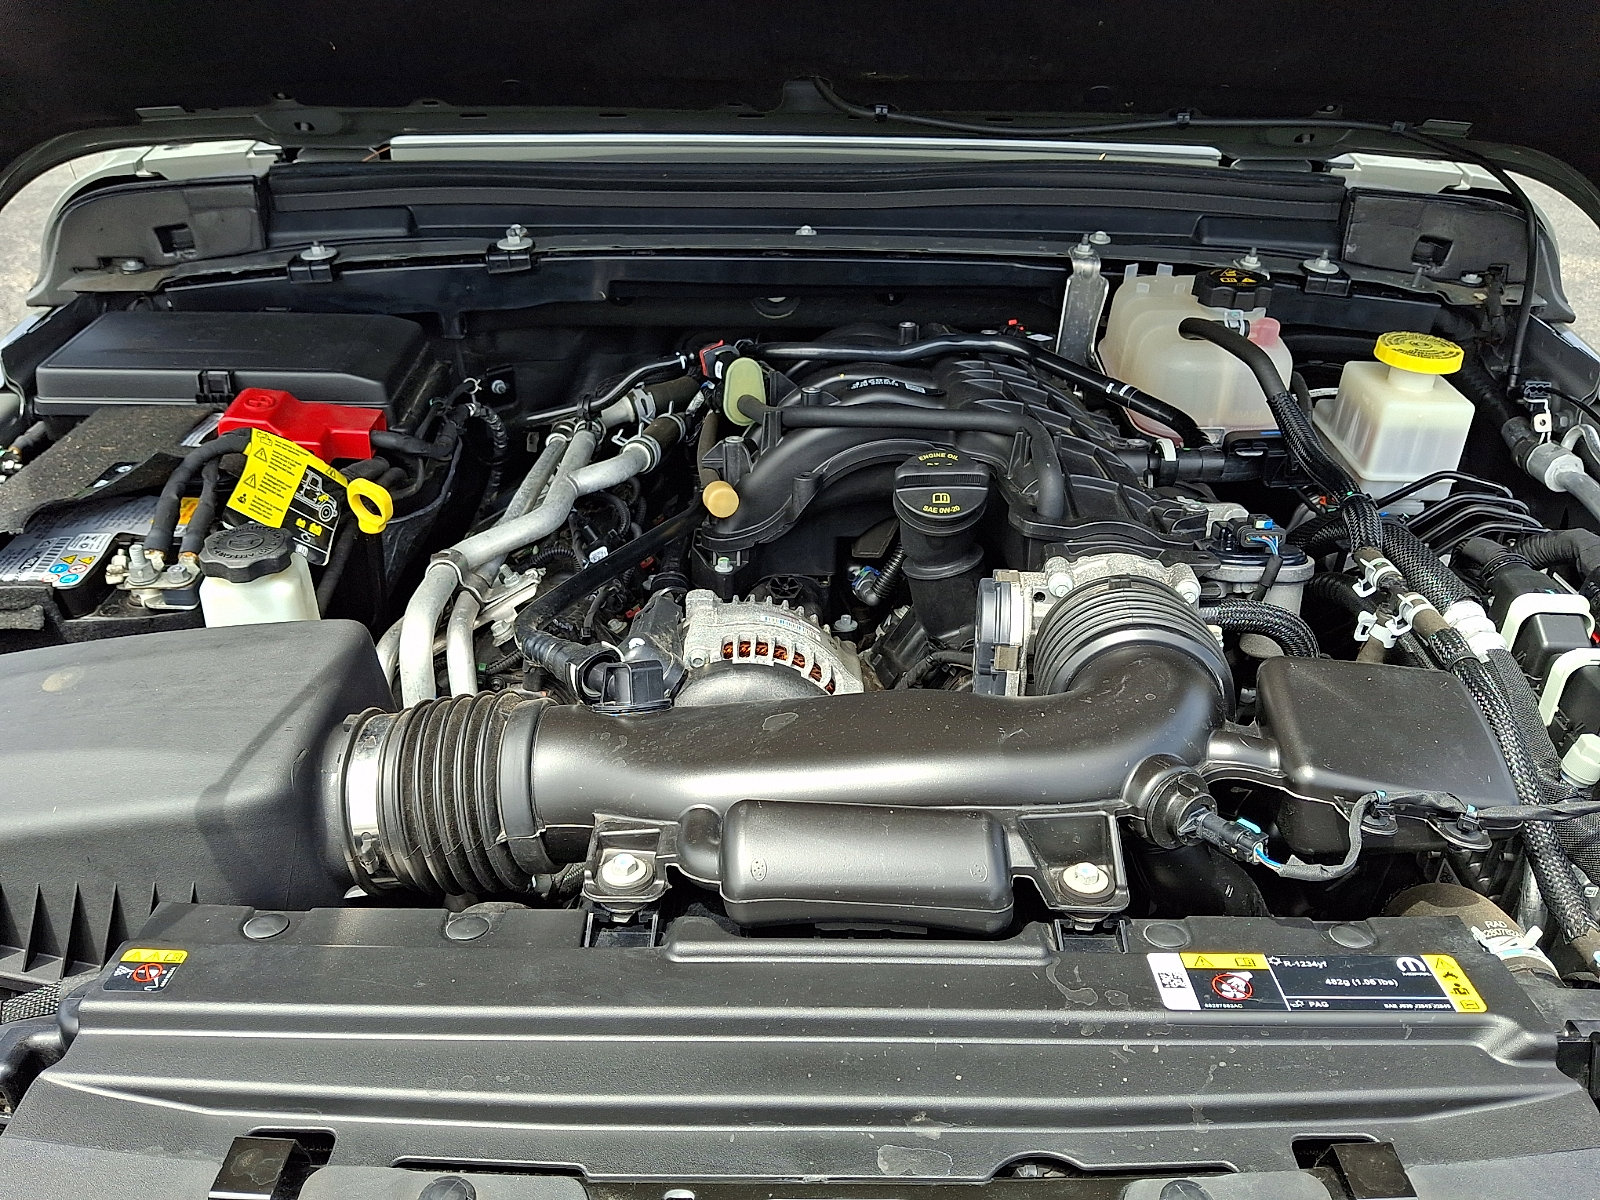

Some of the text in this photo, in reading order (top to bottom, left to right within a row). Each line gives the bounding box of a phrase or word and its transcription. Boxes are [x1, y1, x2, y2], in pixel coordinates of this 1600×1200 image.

[918, 452, 959, 461] ENGINE OIL
[922, 505, 960, 514] SAE 0W-20
[1484, 920, 1508, 929] RAD
[1283, 960, 1328, 969] R-1234yf
